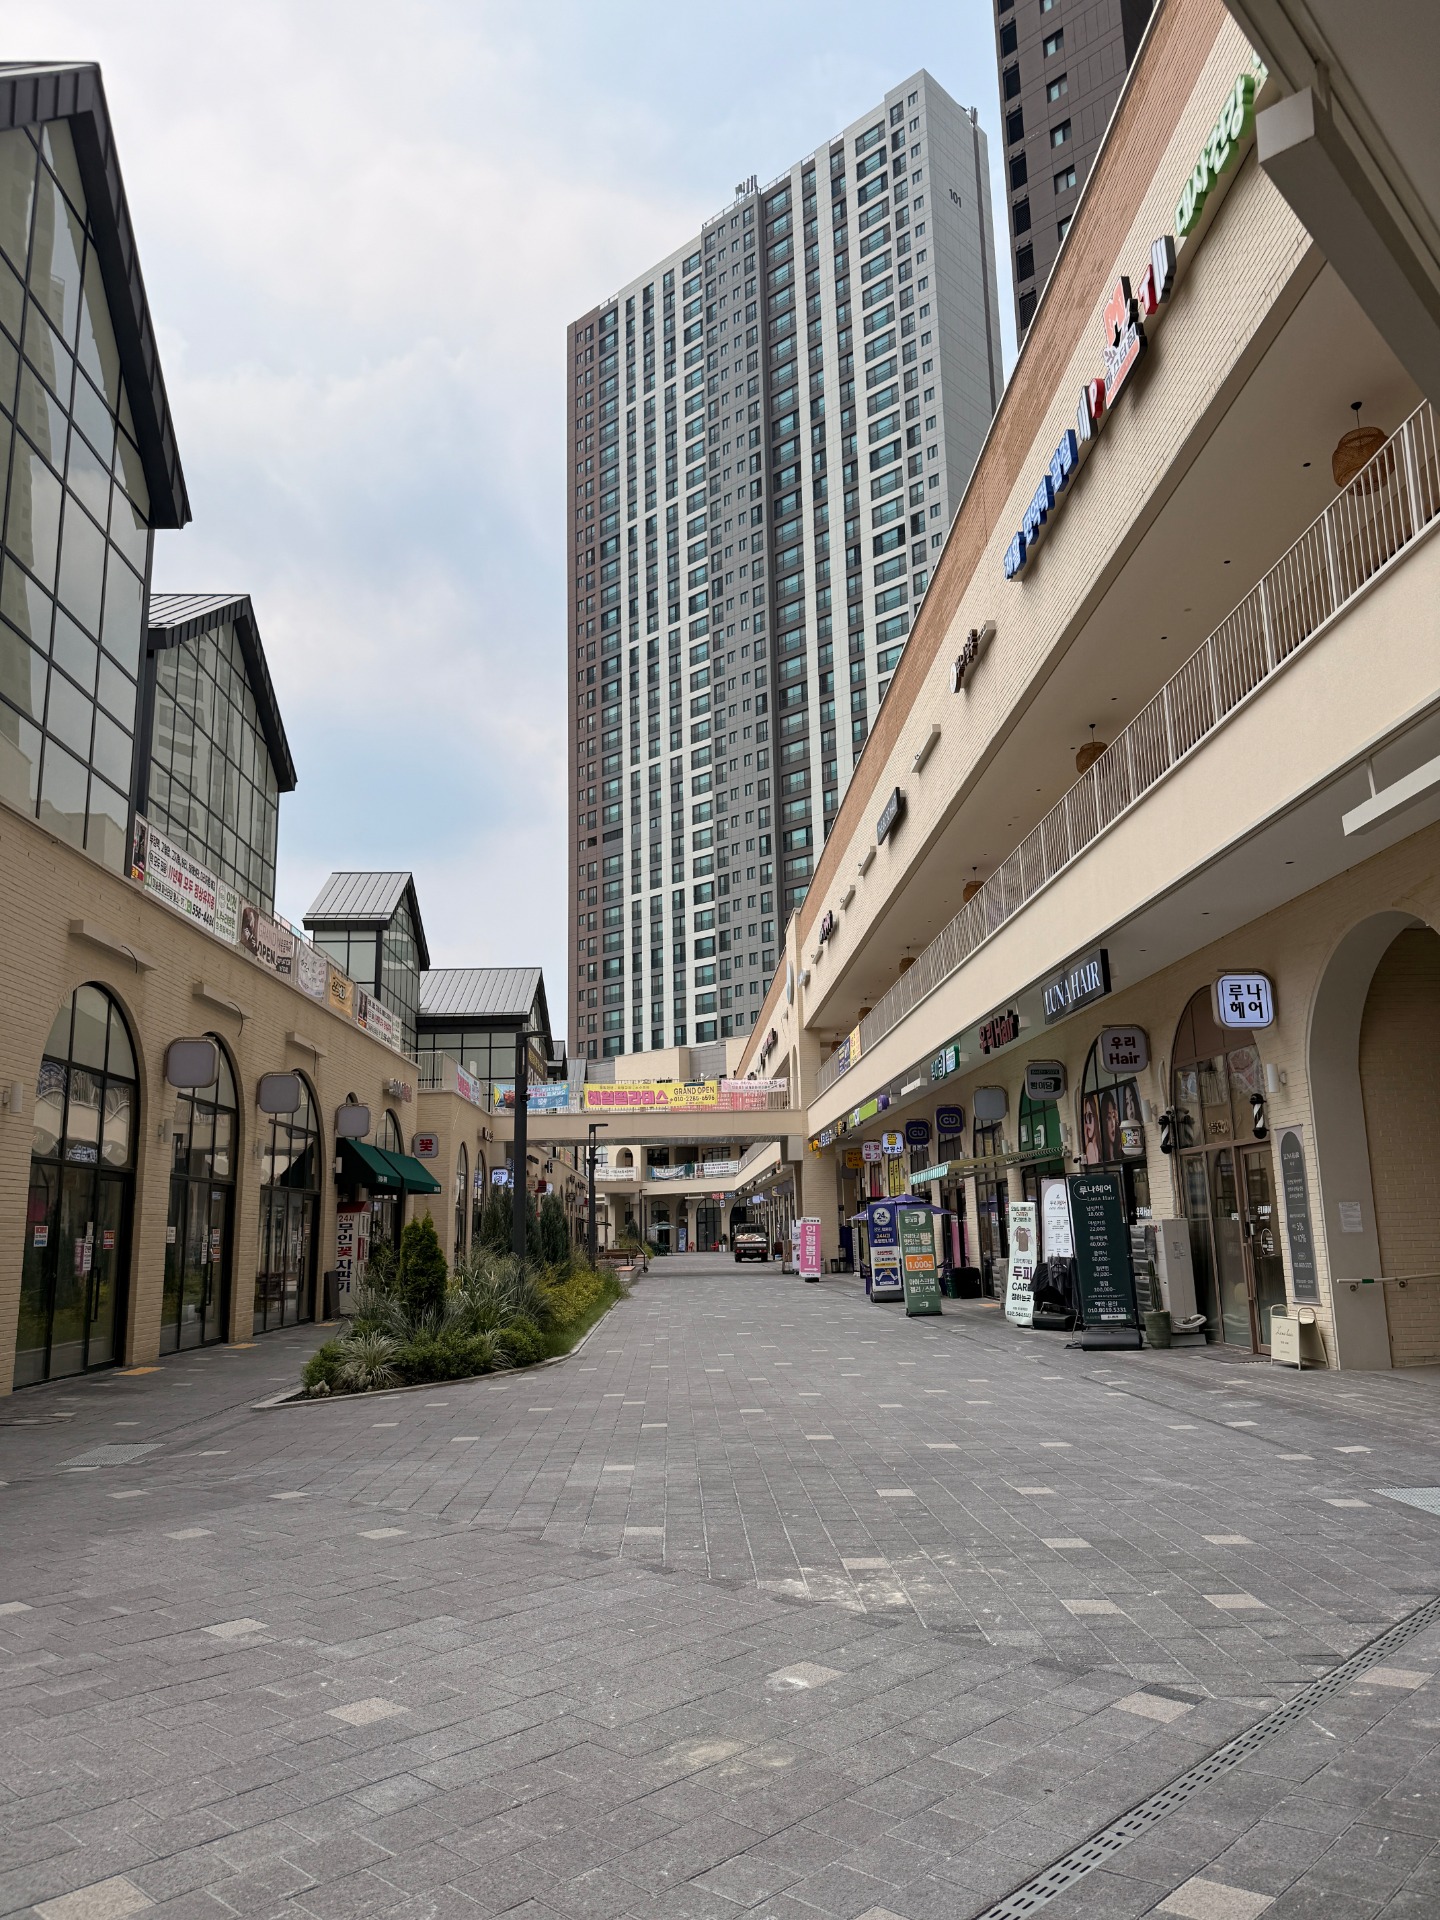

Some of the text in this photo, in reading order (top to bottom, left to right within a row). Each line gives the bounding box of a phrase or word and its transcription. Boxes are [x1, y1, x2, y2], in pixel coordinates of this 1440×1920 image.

[1174, 74, 1250, 237] 대사건강
[949, 189, 961, 208] 101
[257, 941, 277, 966] OPEN
[1045, 961, 1100, 1015] LUNA HAIR
[1229, 984, 1262, 1000] 루나
[1230, 1001, 1263, 1018] 헤어
[1111, 1036, 1136, 1049] 우리
[1109, 1052, 1140, 1064] Hair
[697, 1086, 715, 1094] OPEN
[419, 1139, 434, 1152] 꽃
[1079, 1185, 1112, 1195] 루나헤어
[806, 1225, 816, 1265] 인형뽑기
[920, 1232, 932, 1245] 빵
[1012, 1266, 1032, 1280] 두피
